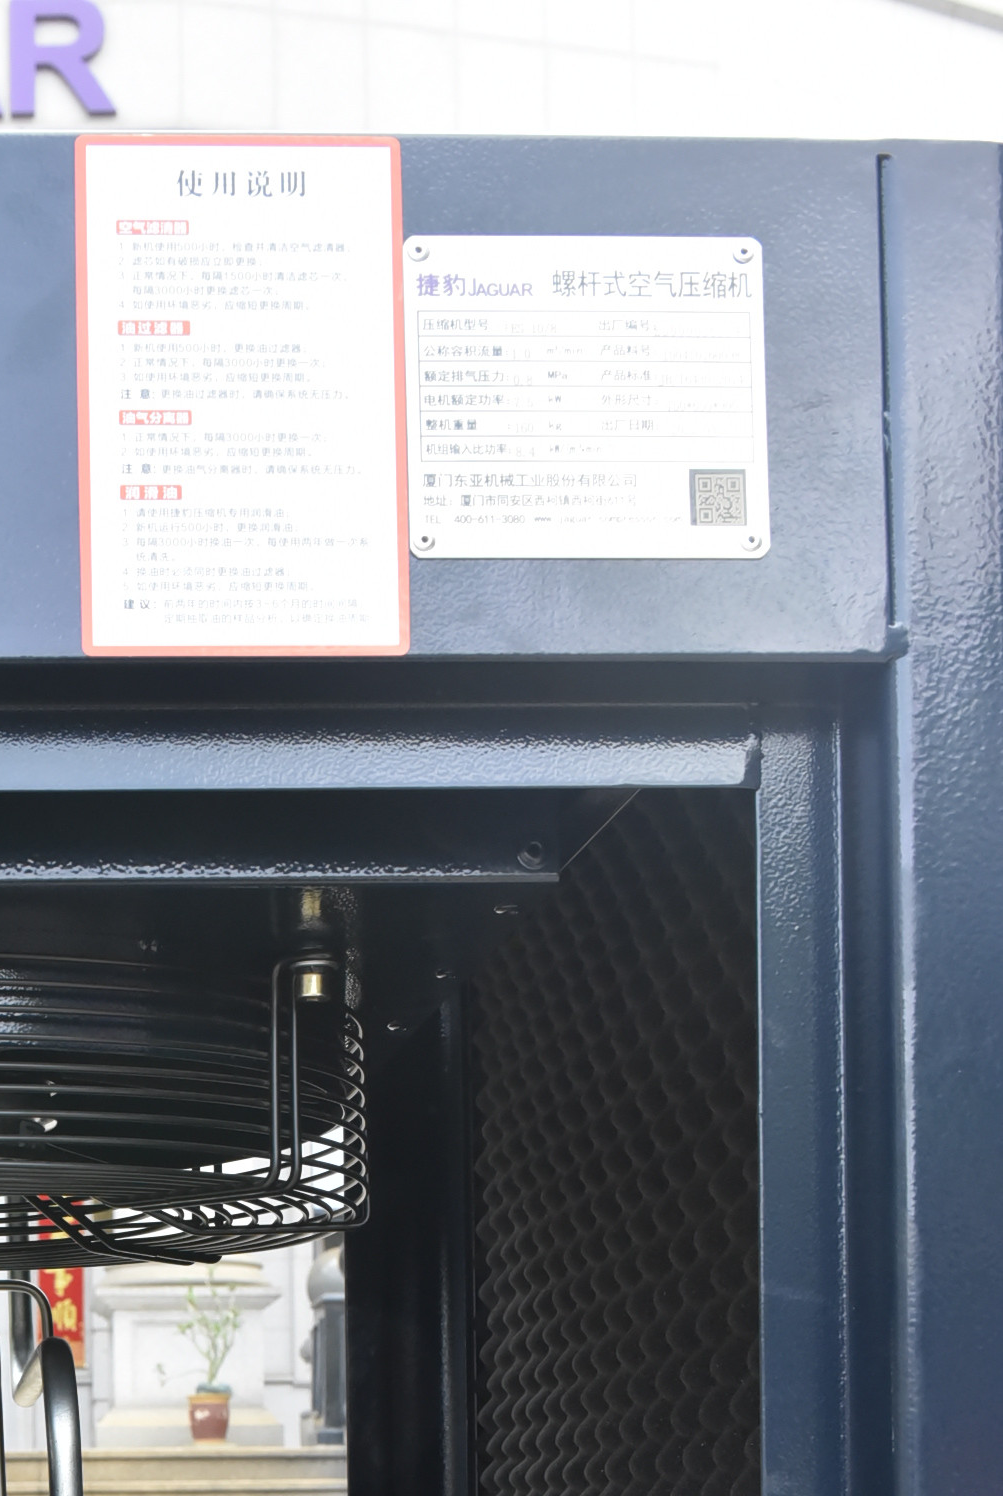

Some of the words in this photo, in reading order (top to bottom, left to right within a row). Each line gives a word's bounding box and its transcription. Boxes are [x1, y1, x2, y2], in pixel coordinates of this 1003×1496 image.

[177, 170, 306, 196] 使用说明
[552, 269, 753, 299] 螺杆式空气压缩机
[121, 322, 183, 334] 油过滤器
[122, 412, 189, 424] 油气分离器
[422, 473, 637, 488] 厦门东亚机械工业股份有限公司
[125, 486, 178, 499] 润滑油
[454, 515, 525, 524] 400-611-3080
